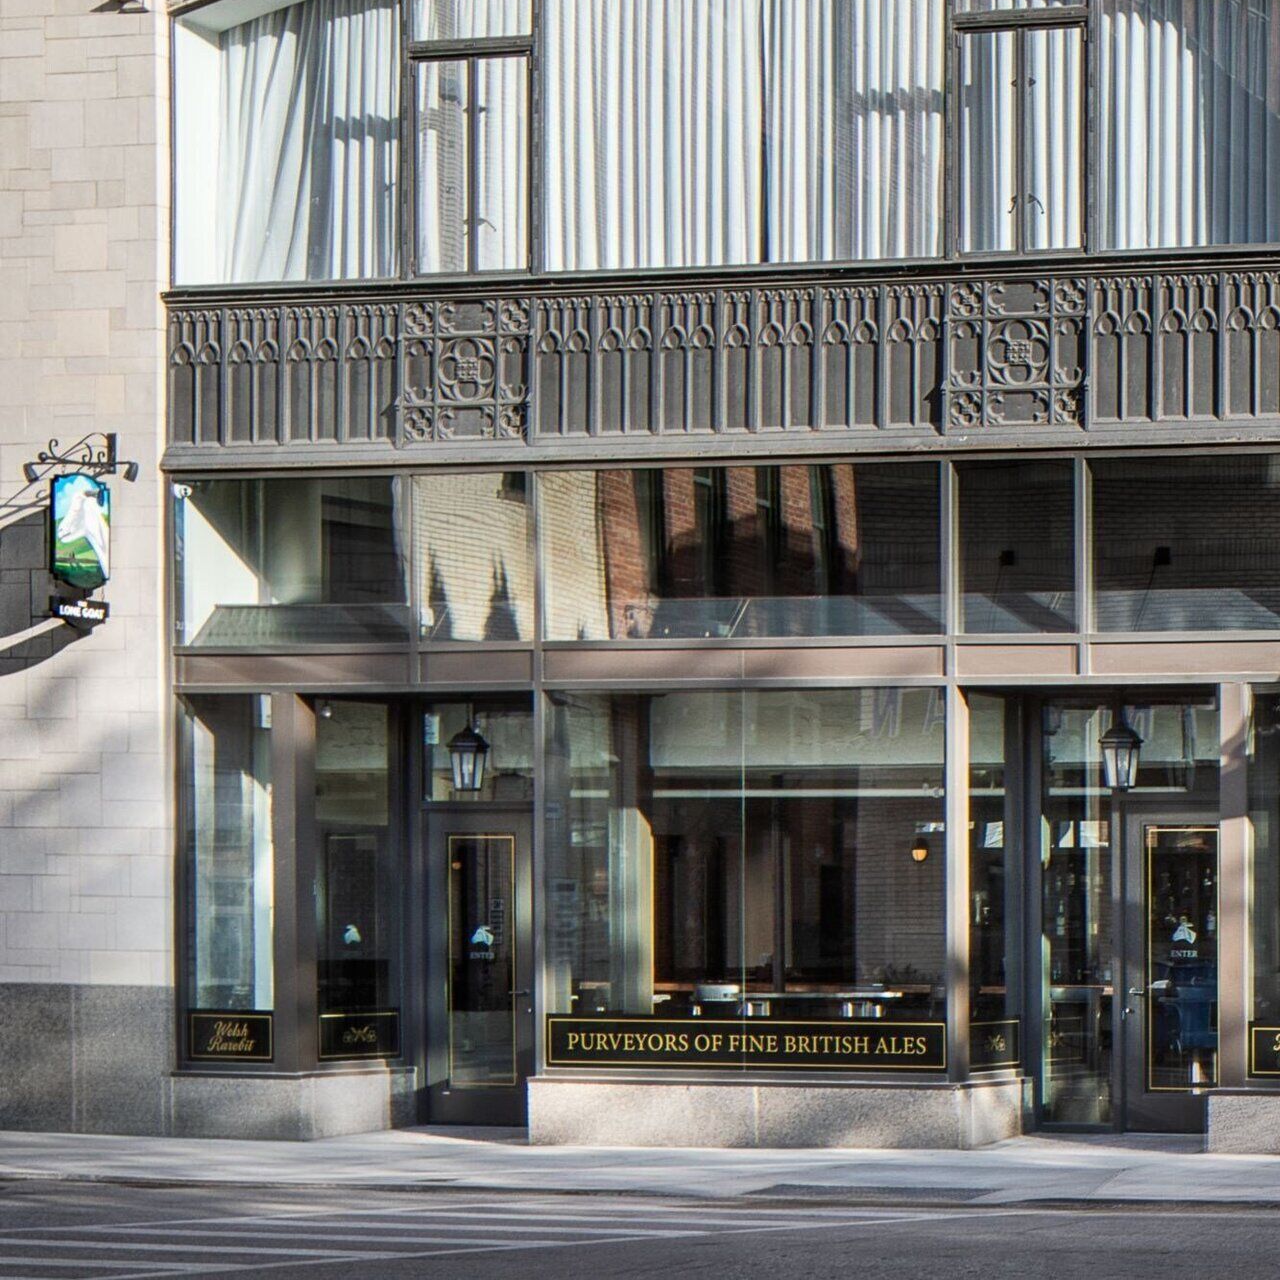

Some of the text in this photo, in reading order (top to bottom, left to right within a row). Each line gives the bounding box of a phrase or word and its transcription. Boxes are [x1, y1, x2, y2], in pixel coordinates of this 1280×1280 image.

[59, 605, 105, 620] LONE GOAT
[1170, 949, 1198, 958] ENTER
[213, 1021, 248, 1037] Welsh
[567, 1033, 927, 1055] PURVEYORS OF FINE BRITISH ALES
